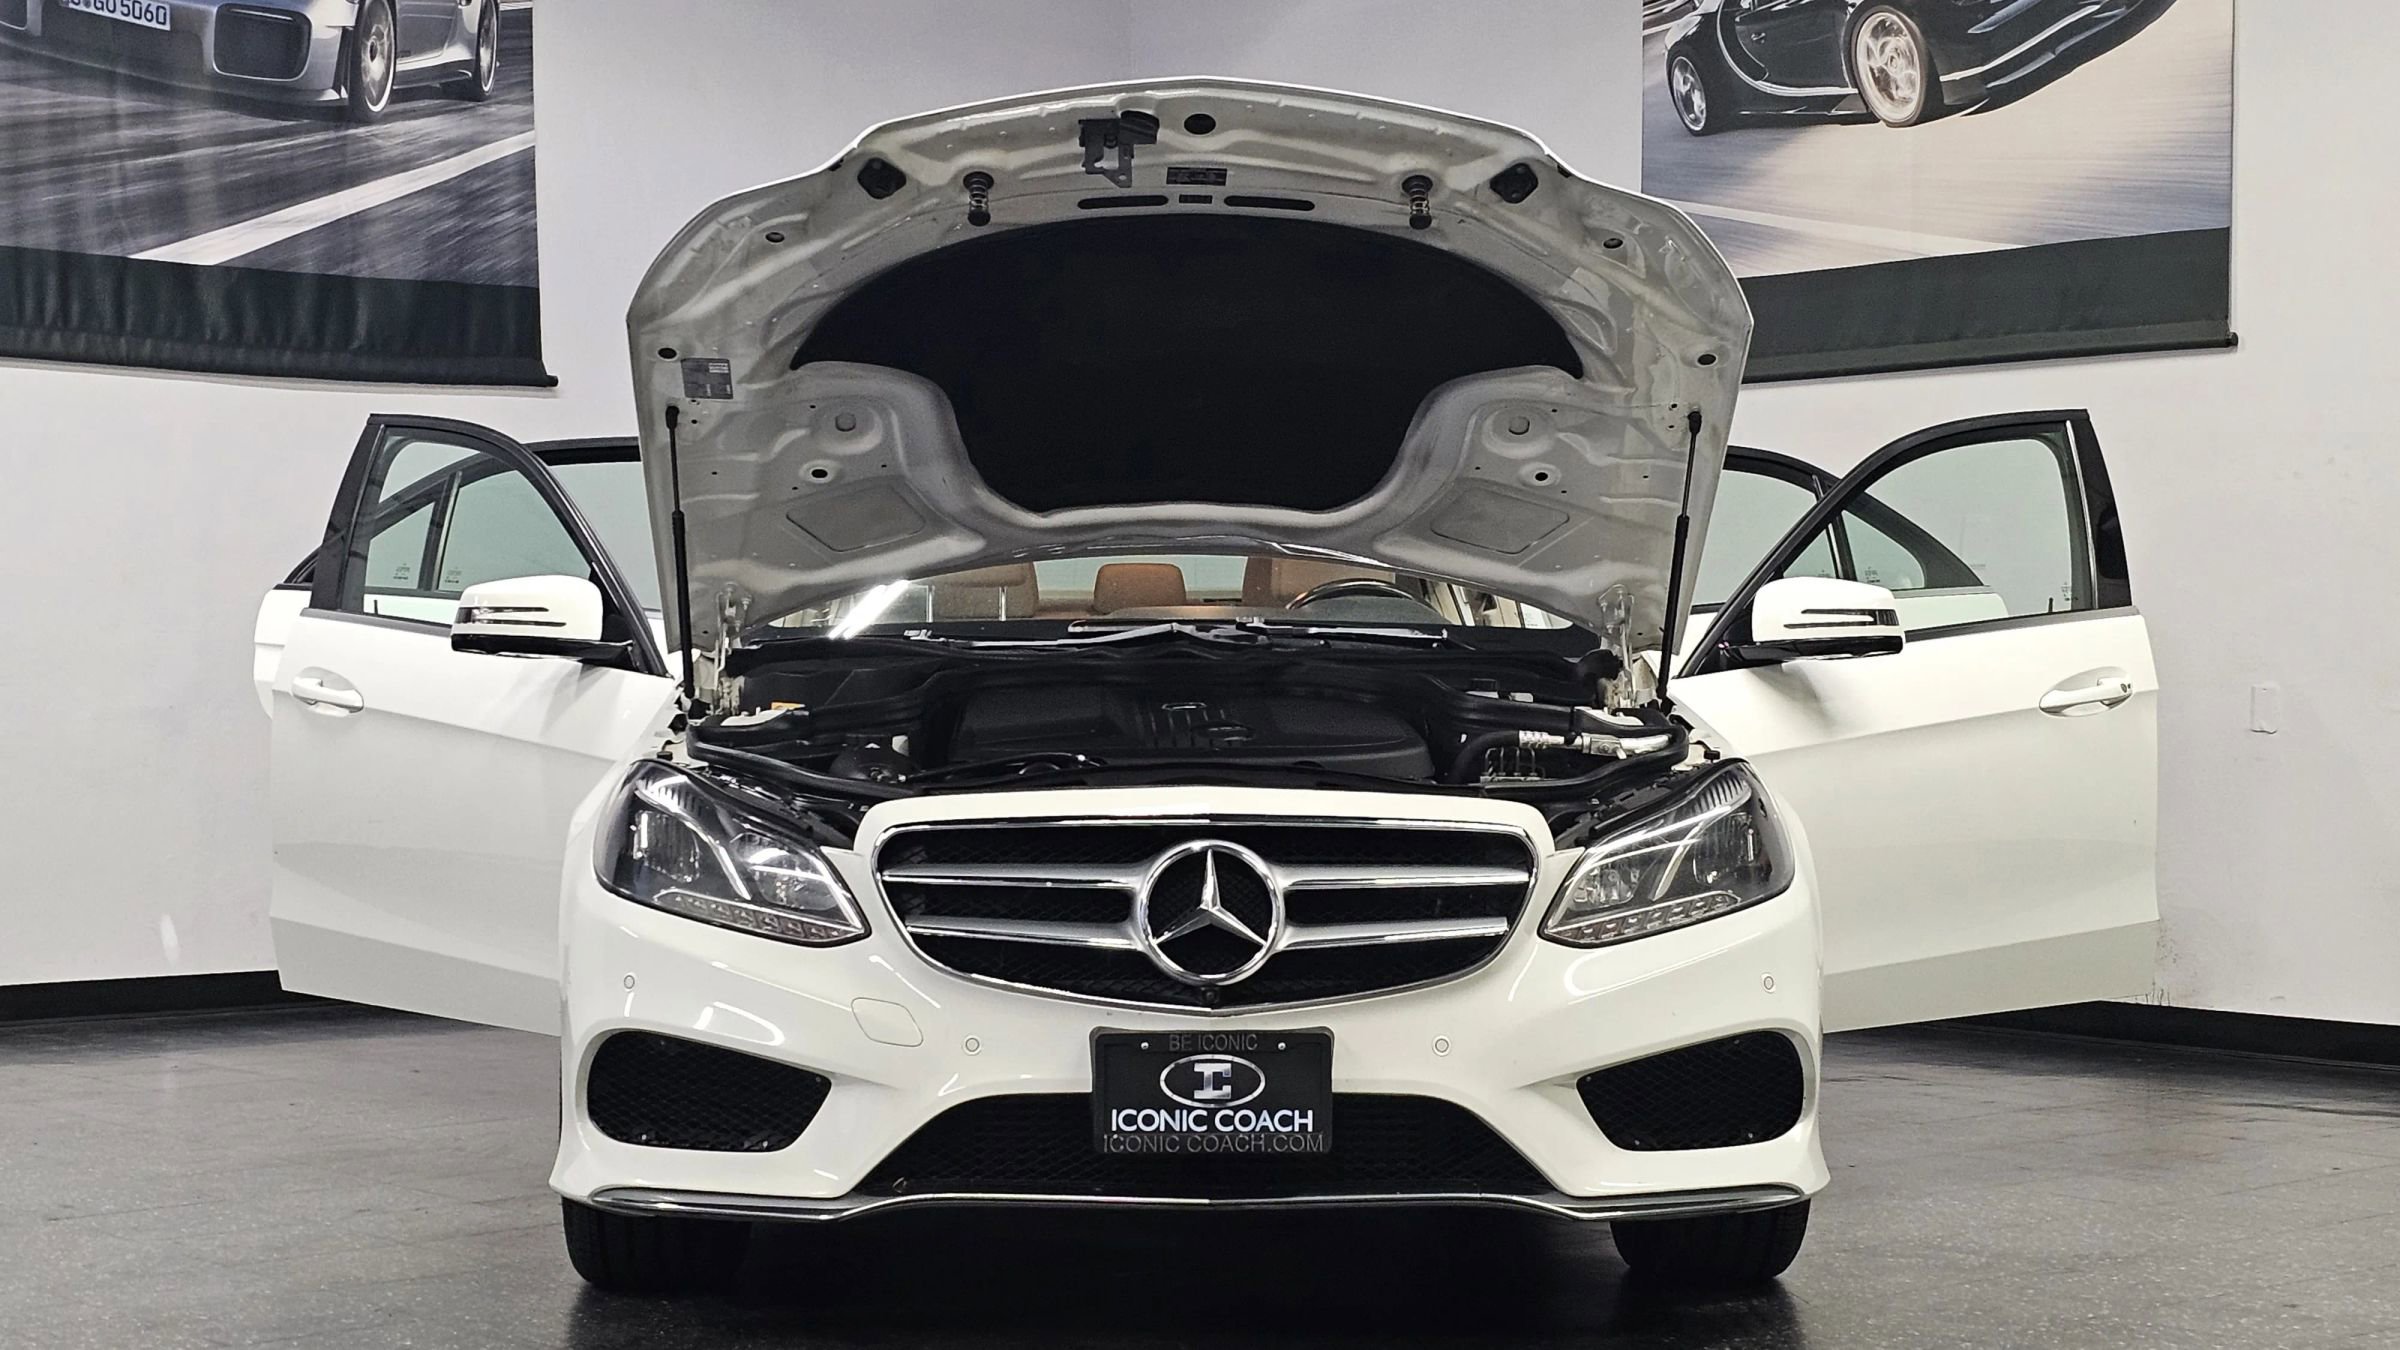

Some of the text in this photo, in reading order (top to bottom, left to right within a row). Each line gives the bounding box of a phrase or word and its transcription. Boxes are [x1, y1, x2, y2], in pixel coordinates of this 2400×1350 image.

[120, 0, 167, 26] 5060
[1168, 1033, 1258, 1051] BE ICONIC
[1111, 1108, 1314, 1133] ICONIC COACH
[1103, 1133, 1324, 1153] ICONIC COACH.COM
